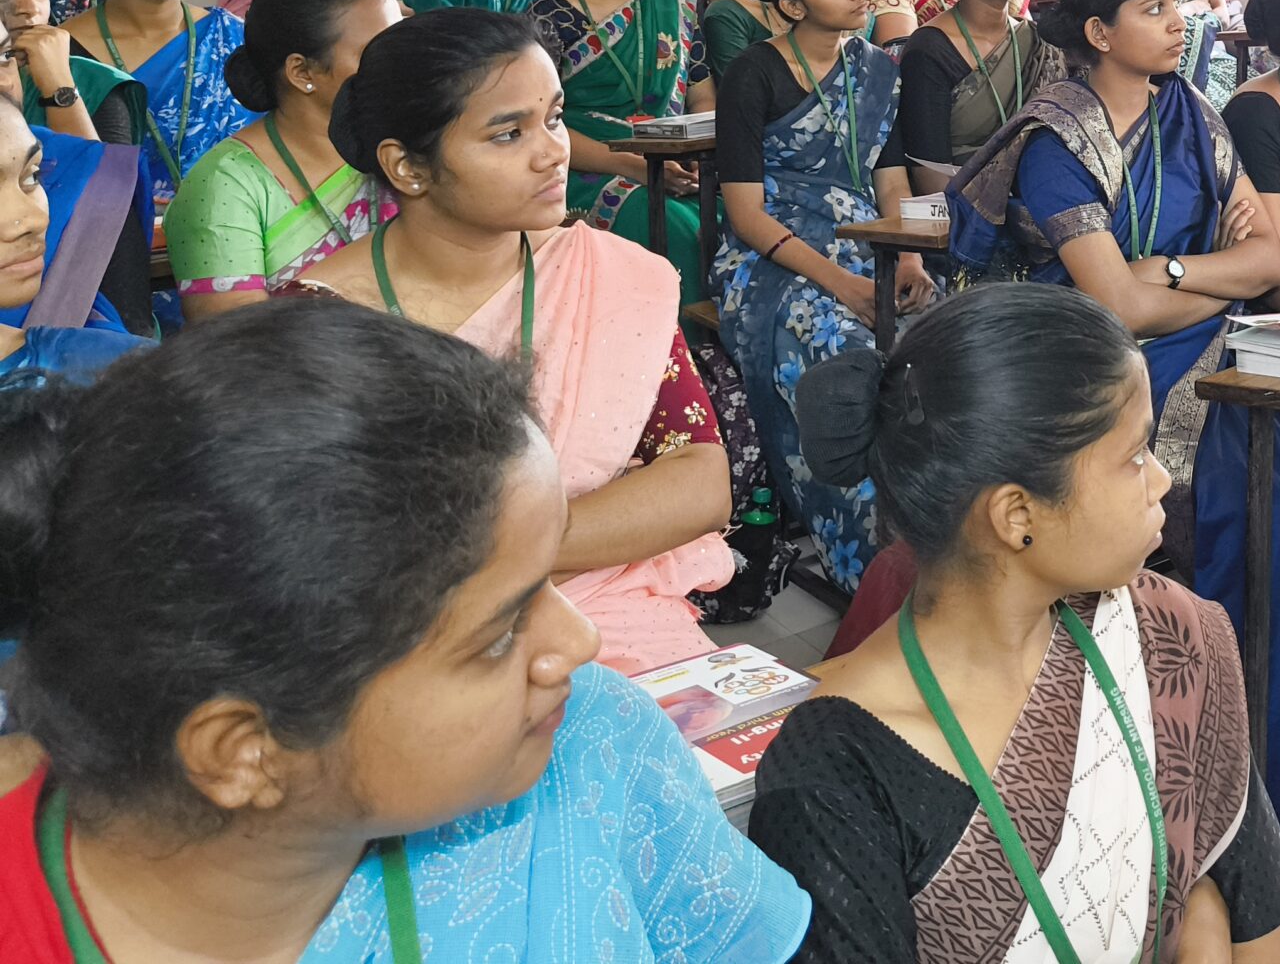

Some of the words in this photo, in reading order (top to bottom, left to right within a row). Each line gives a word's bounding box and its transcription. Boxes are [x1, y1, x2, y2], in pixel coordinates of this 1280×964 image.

[737, 715, 772, 730] Third
[1110, 687, 1140, 743] NURSING
[1134, 745, 1147, 762] OF
[1142, 767, 1162, 818] SCHOOL
